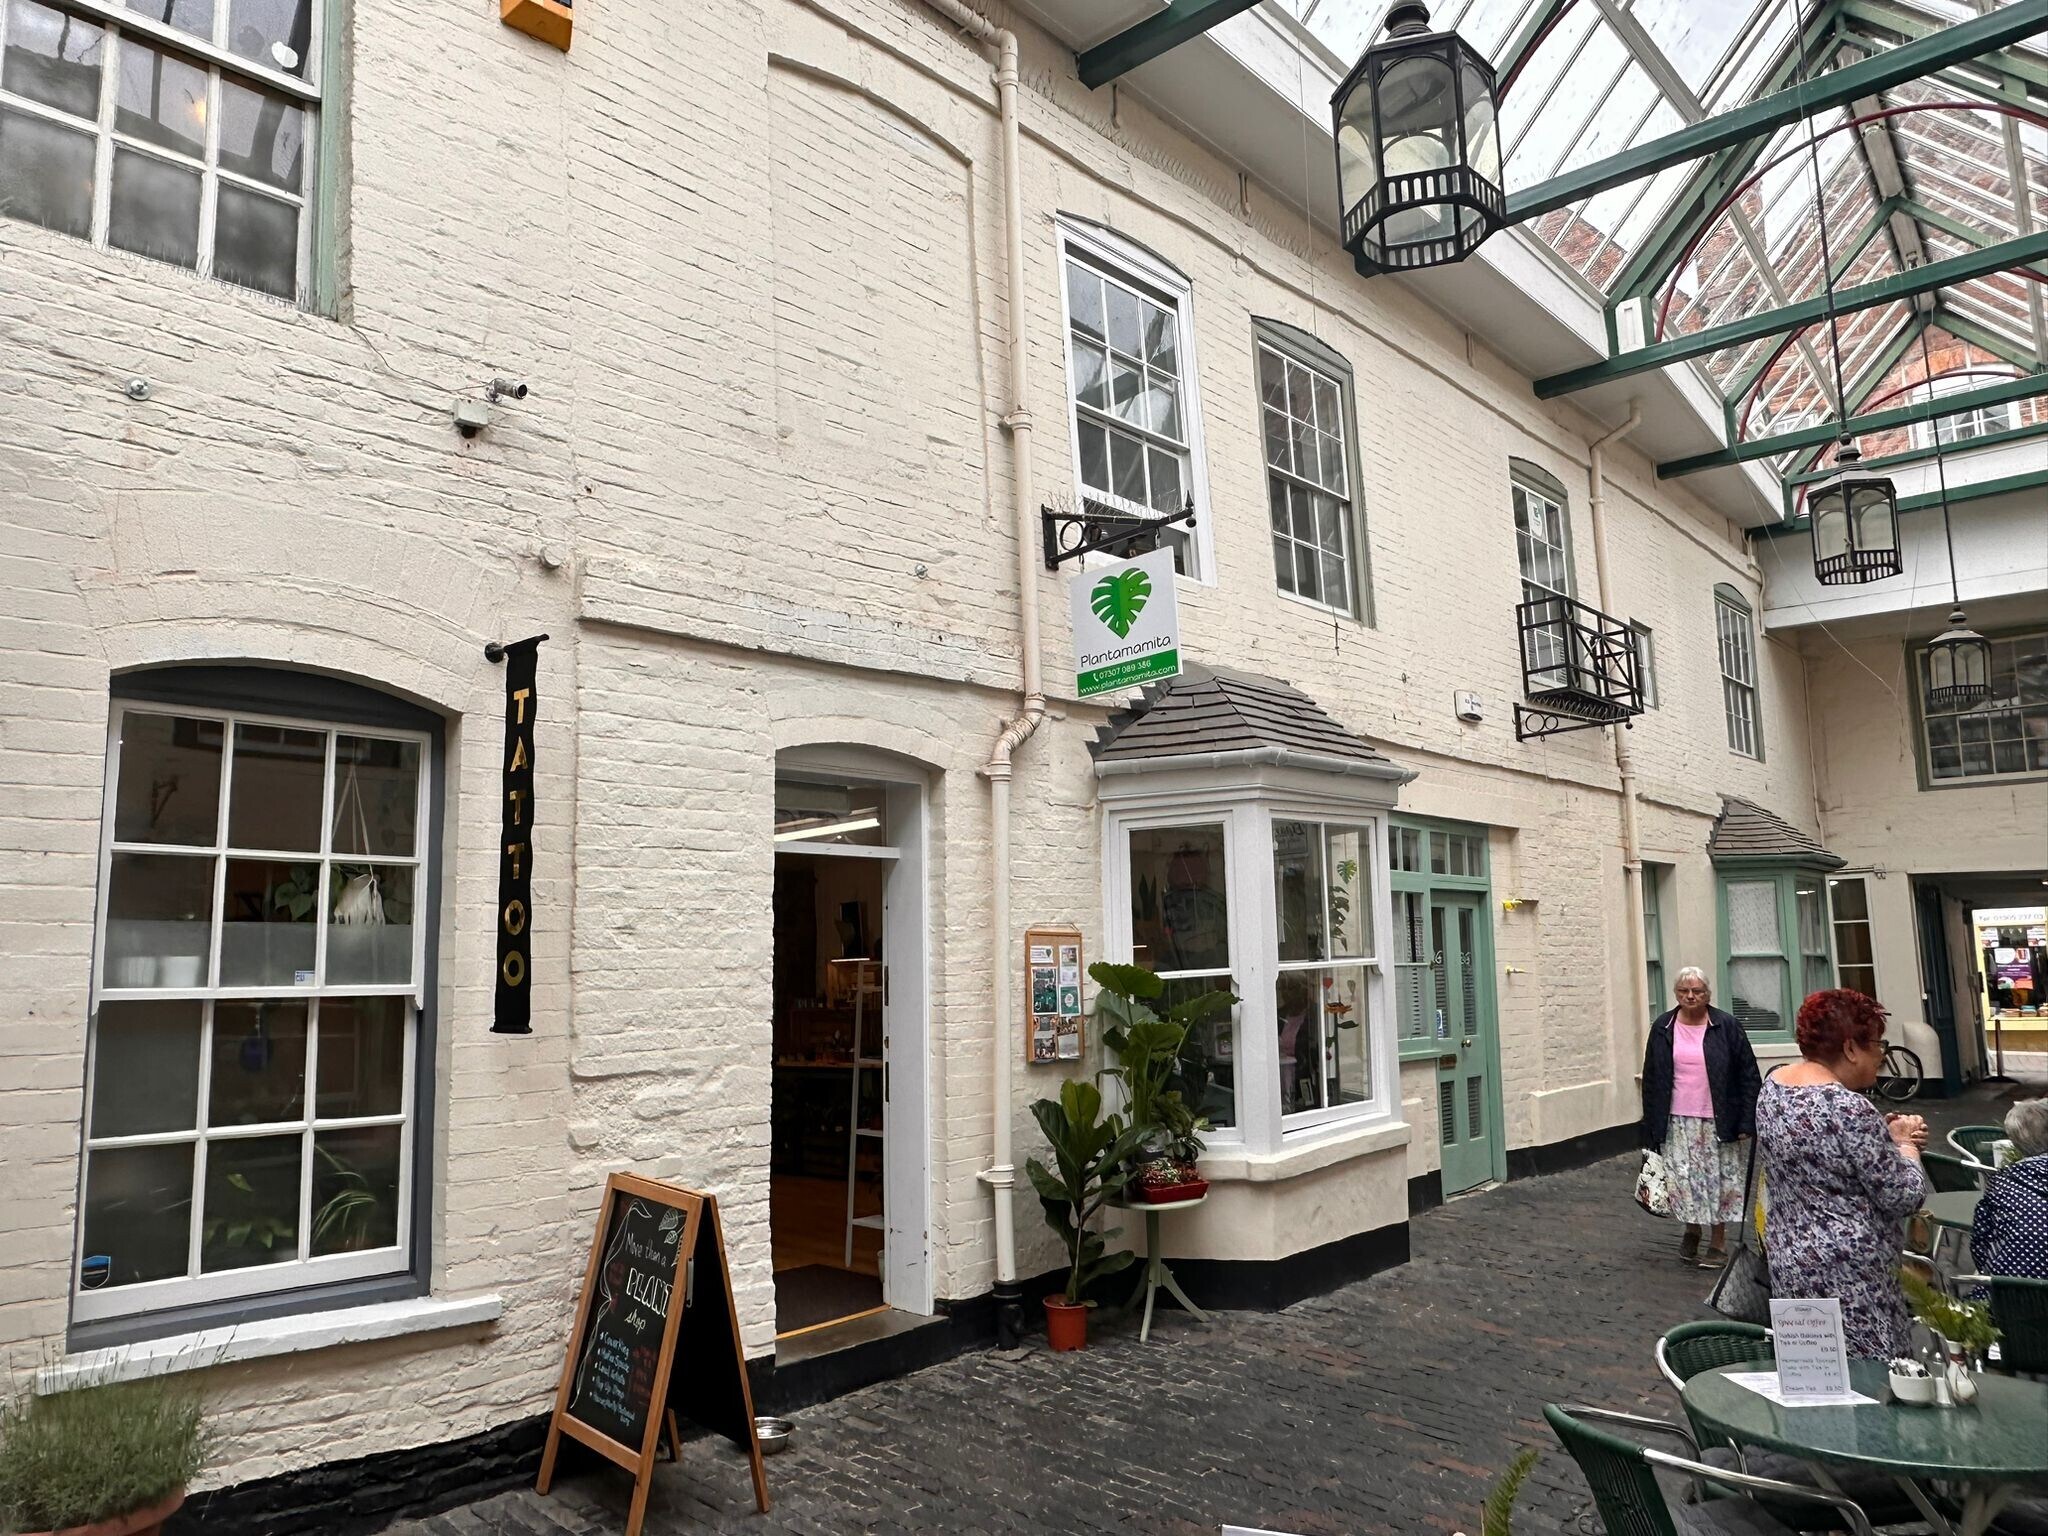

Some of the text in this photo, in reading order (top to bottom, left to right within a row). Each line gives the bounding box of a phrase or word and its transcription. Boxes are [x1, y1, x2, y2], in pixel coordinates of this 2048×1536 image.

[1080, 635, 1171, 667] Plantamamita
[1080, 664, 1176, 694] www.plantamamita.com
[1099, 665, 1121, 680] 07307
[1121, 662, 1136, 676] 089
[503, 687, 529, 987] TATTOO
[625, 1232, 643, 1258] More
[645, 1239, 660, 1263] than
[626, 1267, 674, 1318] PLANT
[625, 1308, 646, 1335] shop
